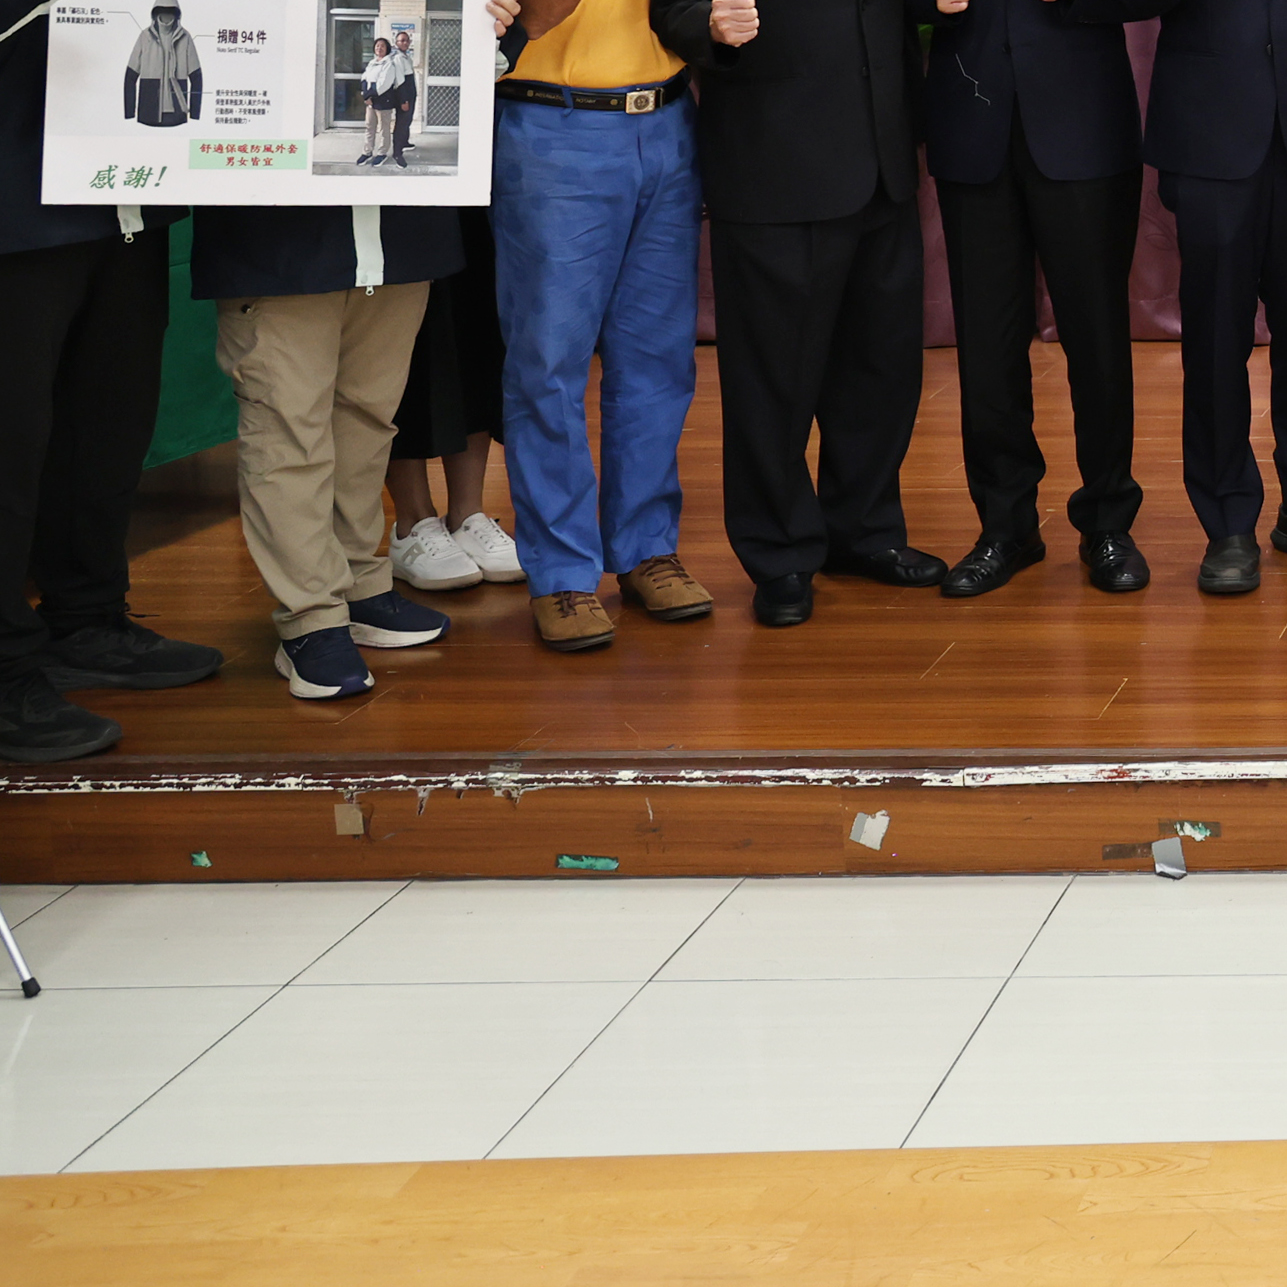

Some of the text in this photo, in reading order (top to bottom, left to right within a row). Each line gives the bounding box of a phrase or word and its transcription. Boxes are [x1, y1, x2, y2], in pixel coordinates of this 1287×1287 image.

[241, 30, 254, 44] 94
[256, 29, 267, 45] 件
[199, 143, 299, 154] 舒適保暖防風外套
[225, 156, 274, 167] 男女皆宜
